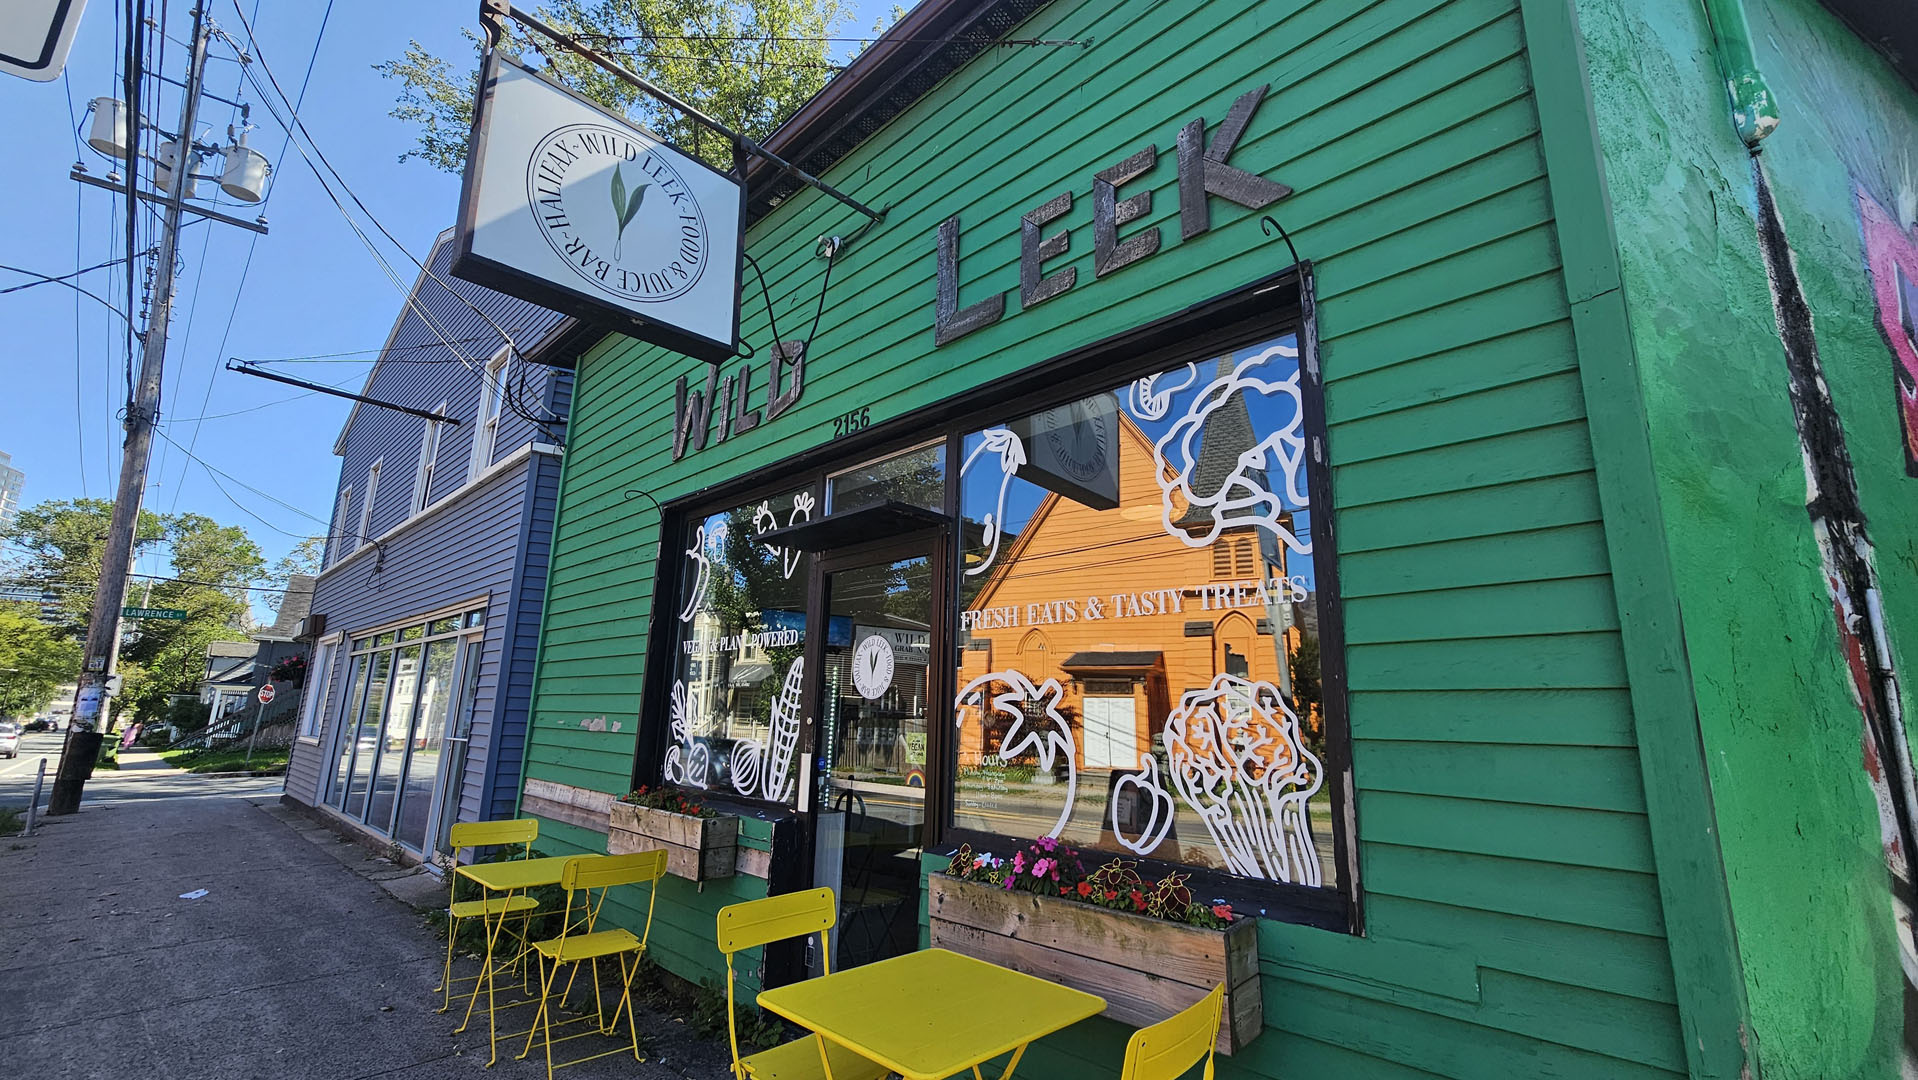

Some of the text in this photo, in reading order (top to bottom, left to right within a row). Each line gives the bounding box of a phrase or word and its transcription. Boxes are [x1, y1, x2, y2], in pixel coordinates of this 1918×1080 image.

[537, 132, 701, 294] WILD LEEK FOOD & JUICE BAR HALIFAX
[935, 83, 1293, 347] LEEK
[671, 339, 805, 463] WILD
[833, 407, 871, 440] 2156
[125, 608, 174, 618] LAWRENCE
[960, 575, 1308, 631] FRESH EATS & TASTY TREATS
[683, 638, 708, 655] VEGA
[751, 629, 799, 649] POWERED
[259, 689, 274, 699] STOP
